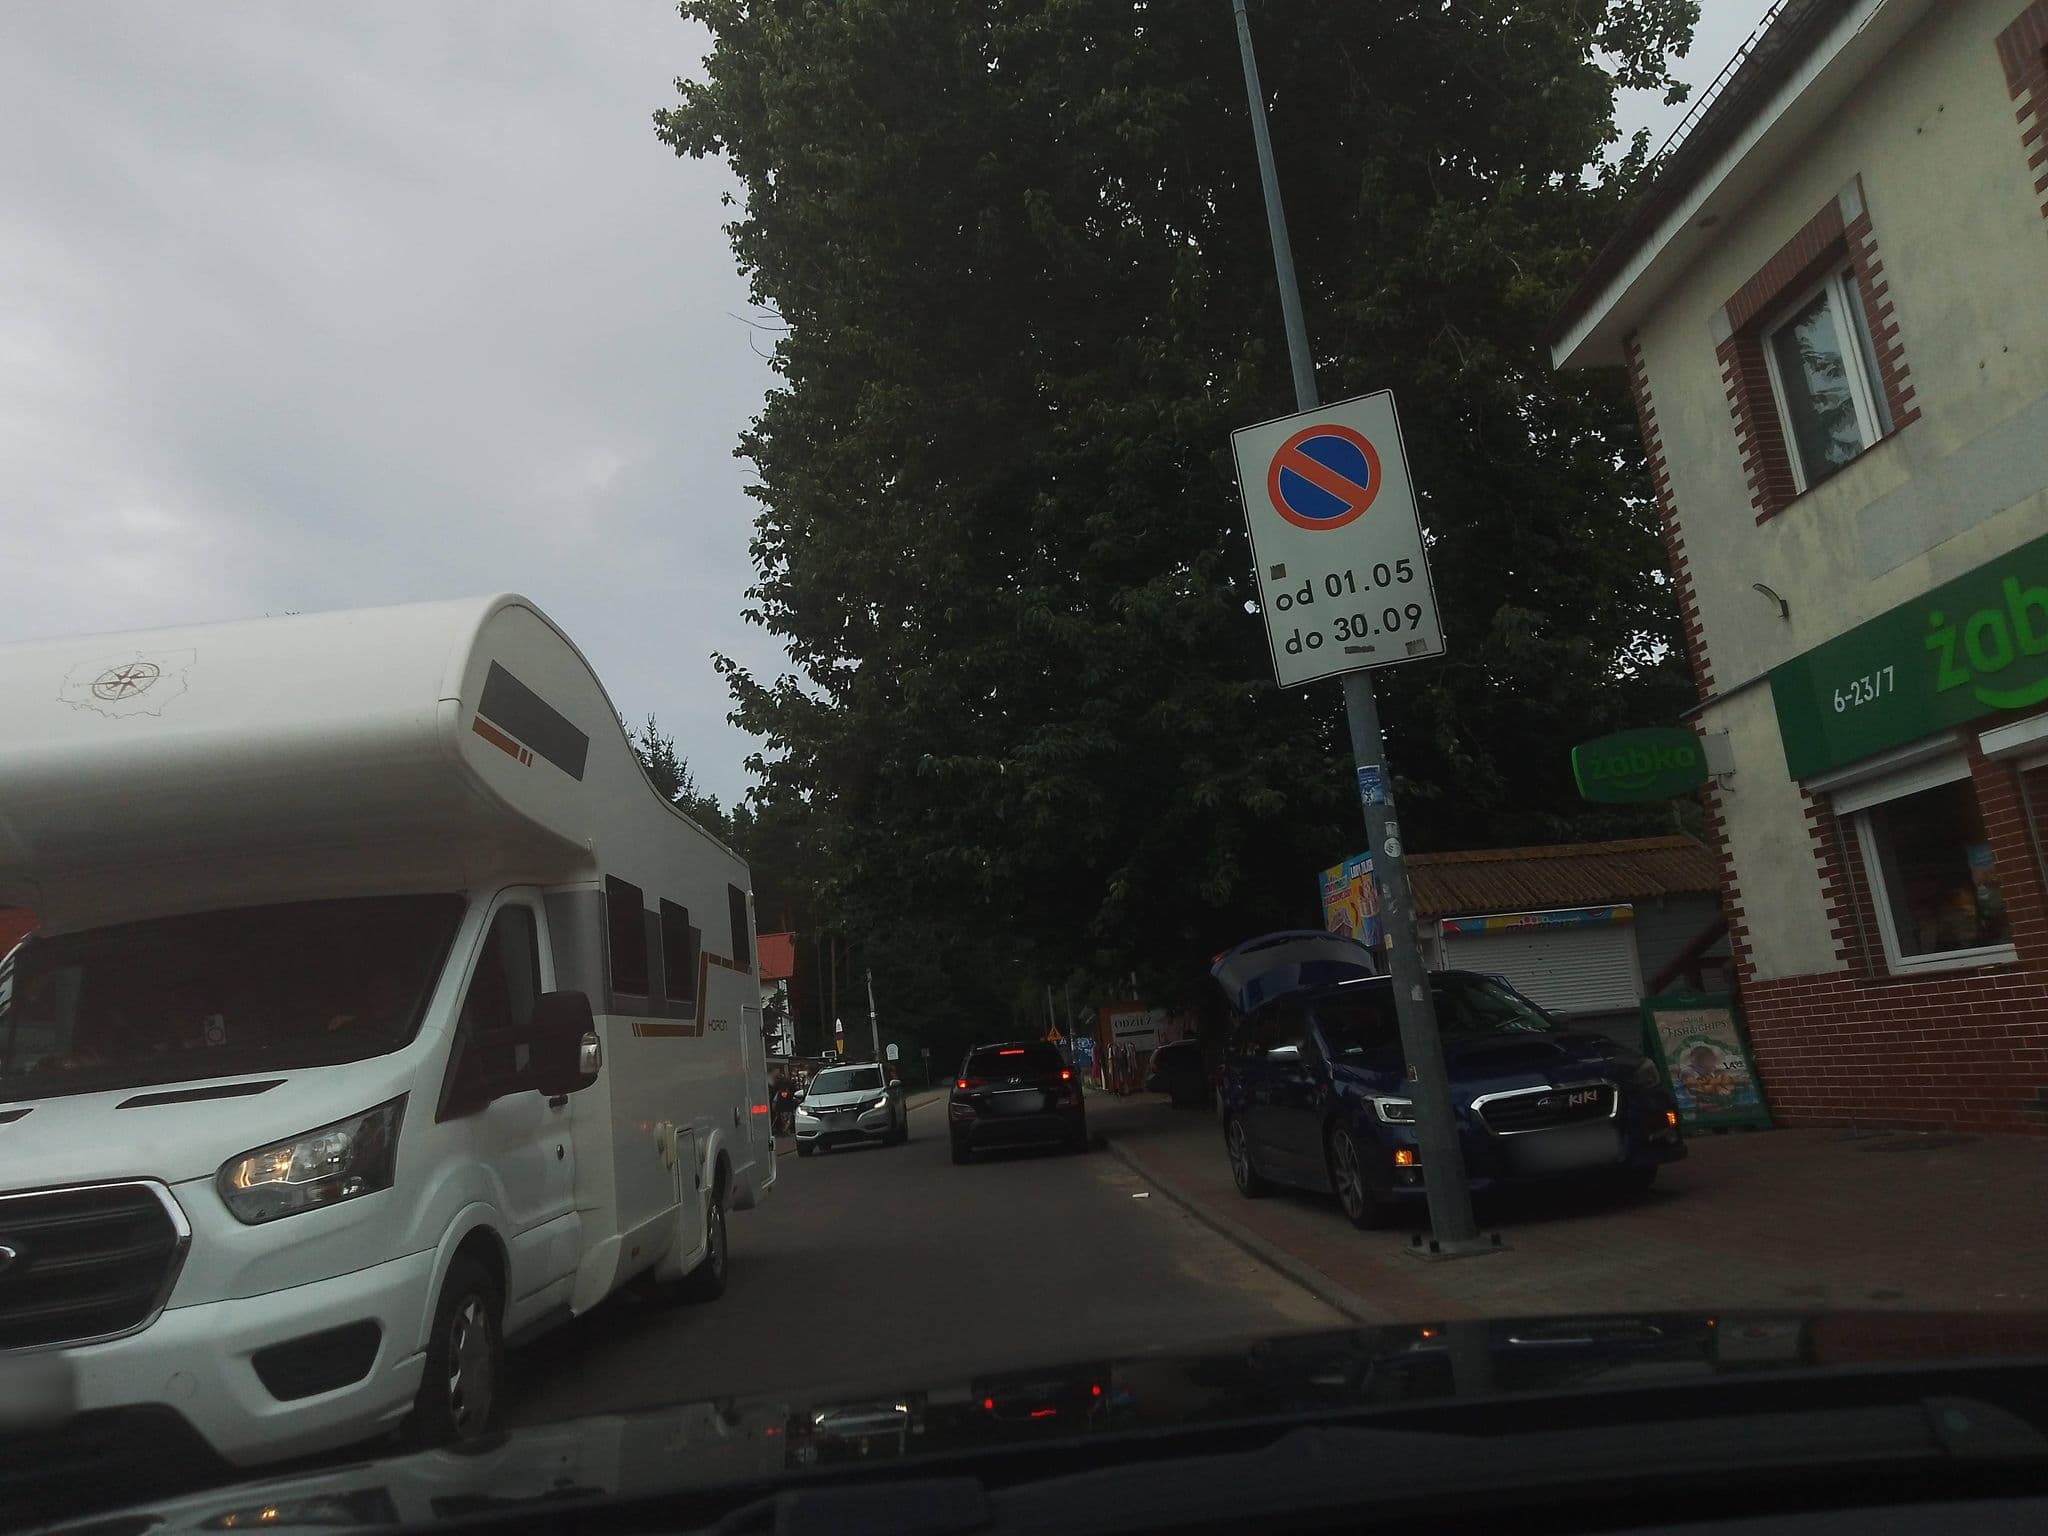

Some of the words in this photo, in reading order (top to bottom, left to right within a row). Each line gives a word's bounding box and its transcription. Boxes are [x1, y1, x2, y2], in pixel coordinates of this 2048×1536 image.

[1276, 579, 1314, 611] od
[1325, 558, 1414, 598] 01.05
[1285, 628, 1323, 655] do
[1333, 603, 1423, 642] 30.09
[1833, 664, 1895, 713] 6-23/7
[1569, 1089, 1598, 1108] KIKI
